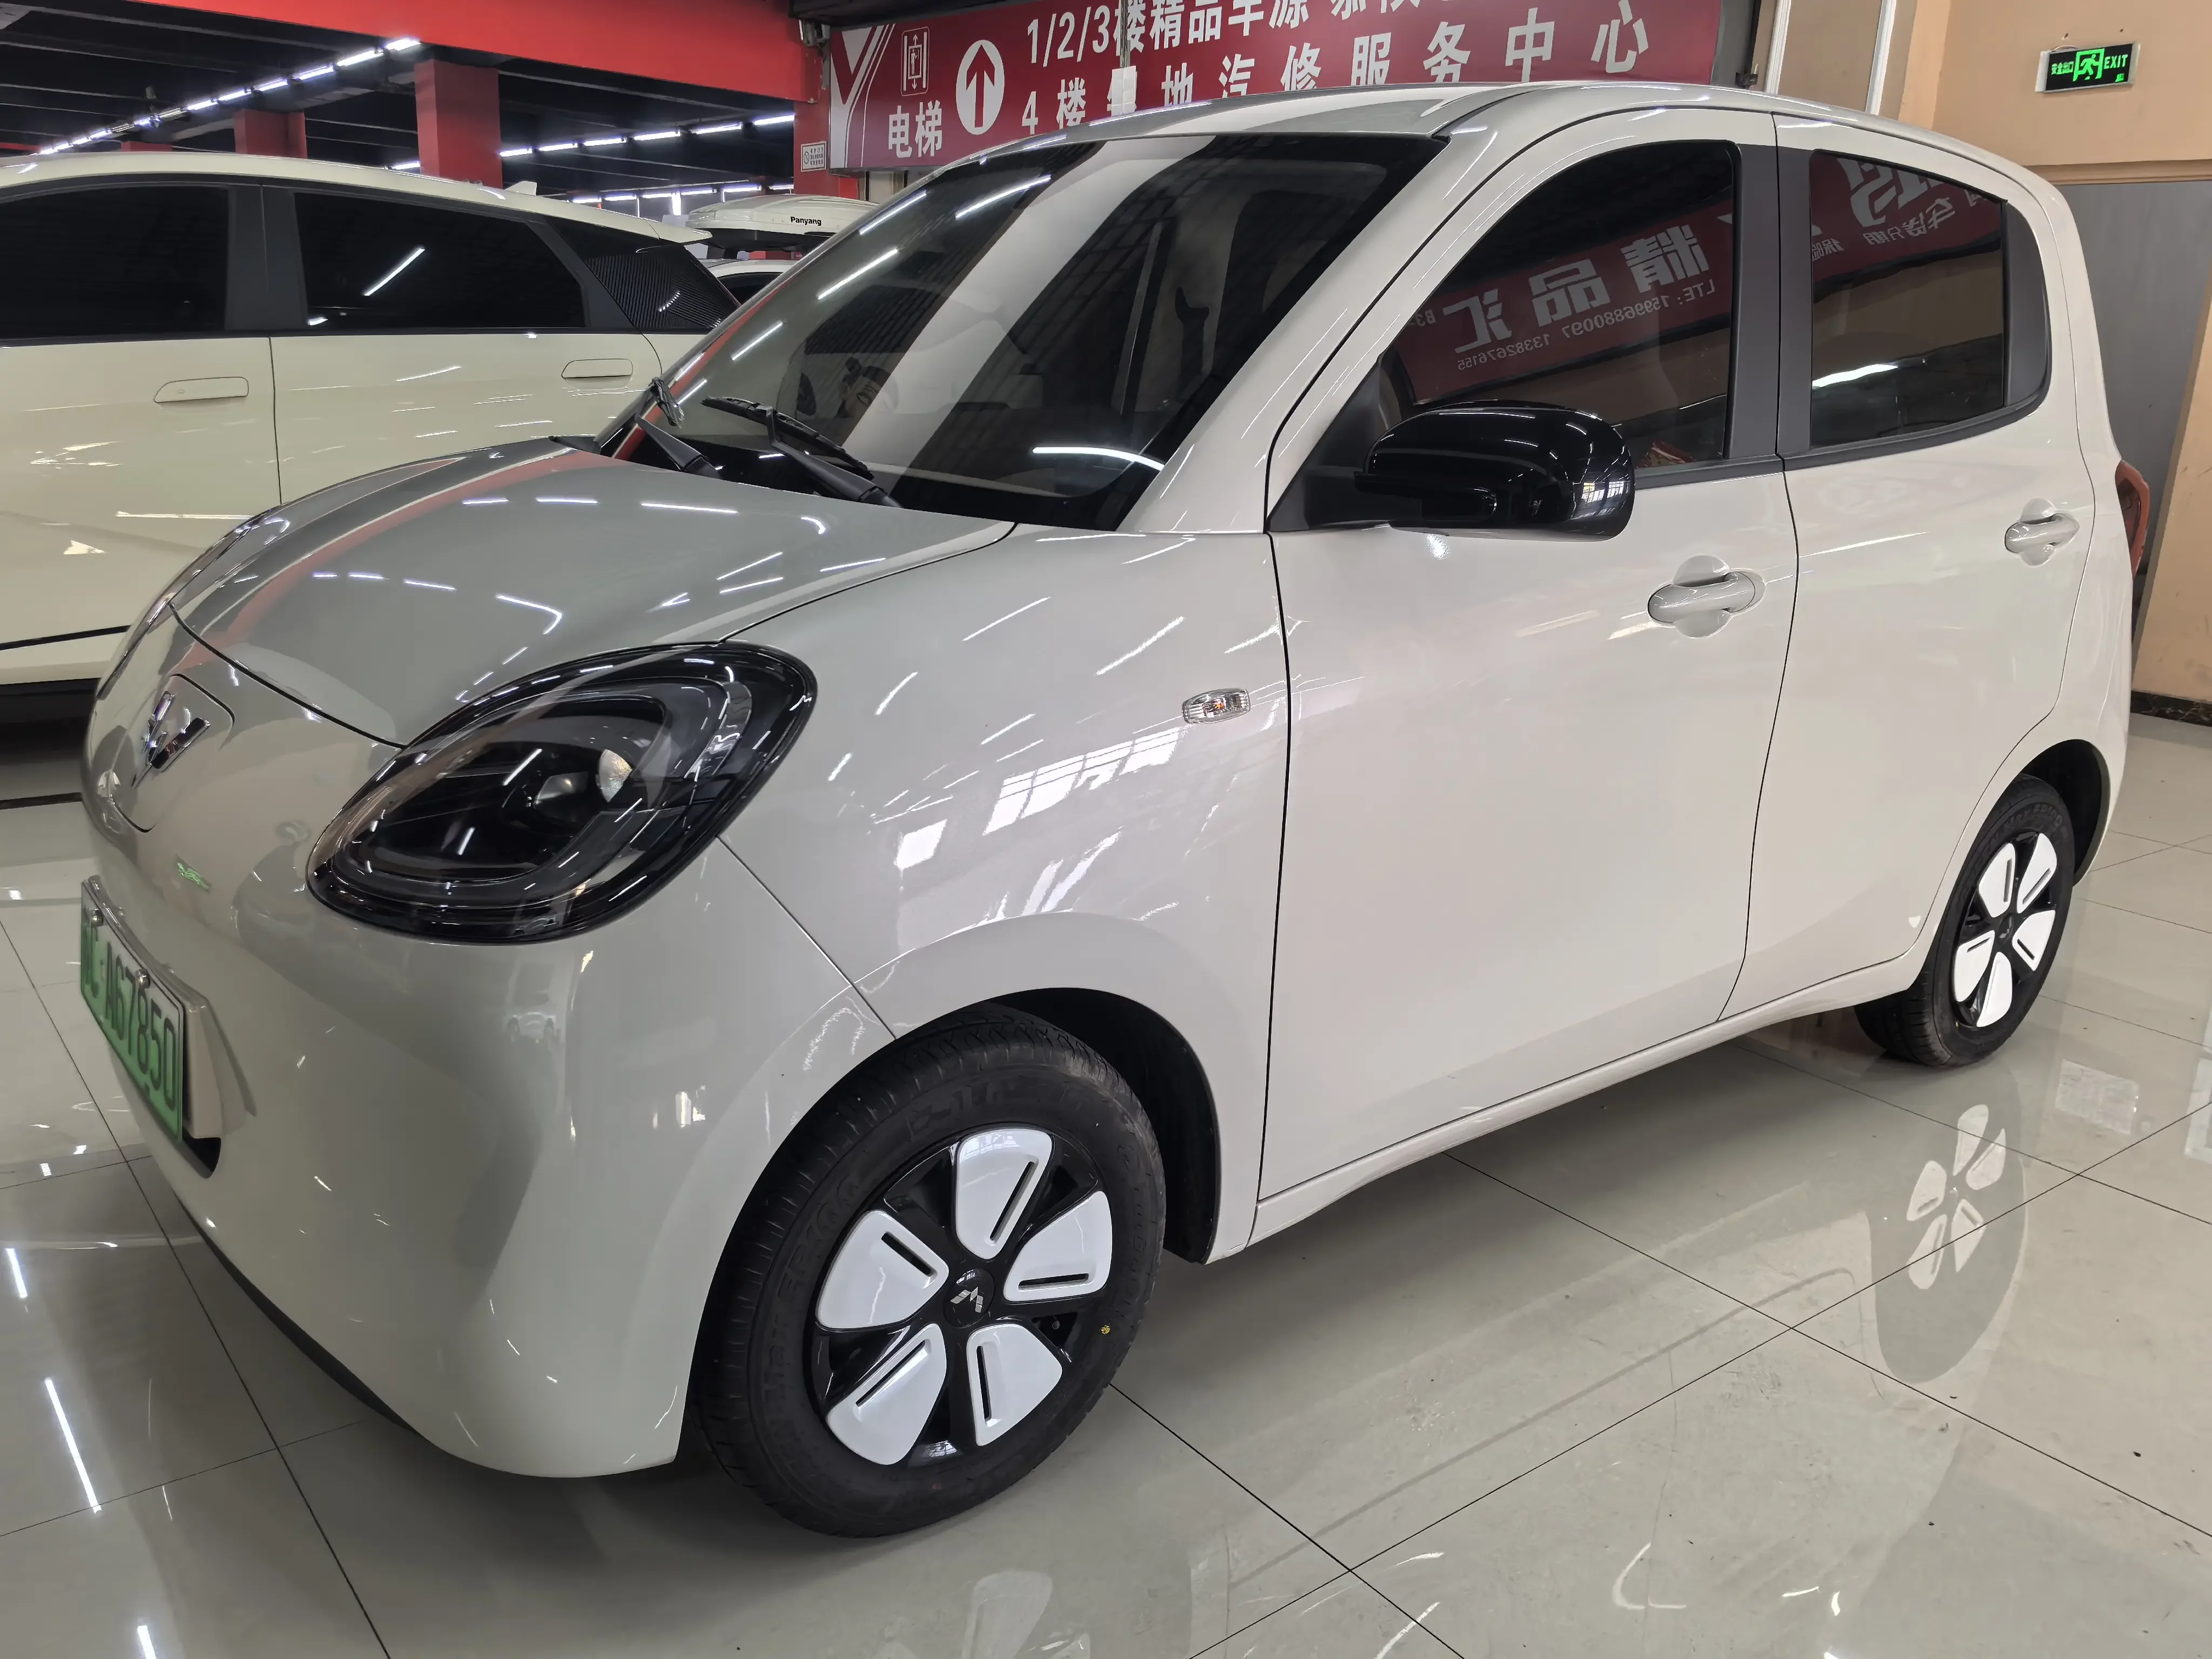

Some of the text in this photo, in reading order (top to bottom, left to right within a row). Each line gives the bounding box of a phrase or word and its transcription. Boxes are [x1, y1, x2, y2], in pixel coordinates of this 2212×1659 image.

[1022, 4, 1649, 134] 4楼地汽修服务中心
[2103, 55, 2128, 69] EXIT
[888, 100, 942, 158] 电梯
[790, 216, 821, 226] Panyang
